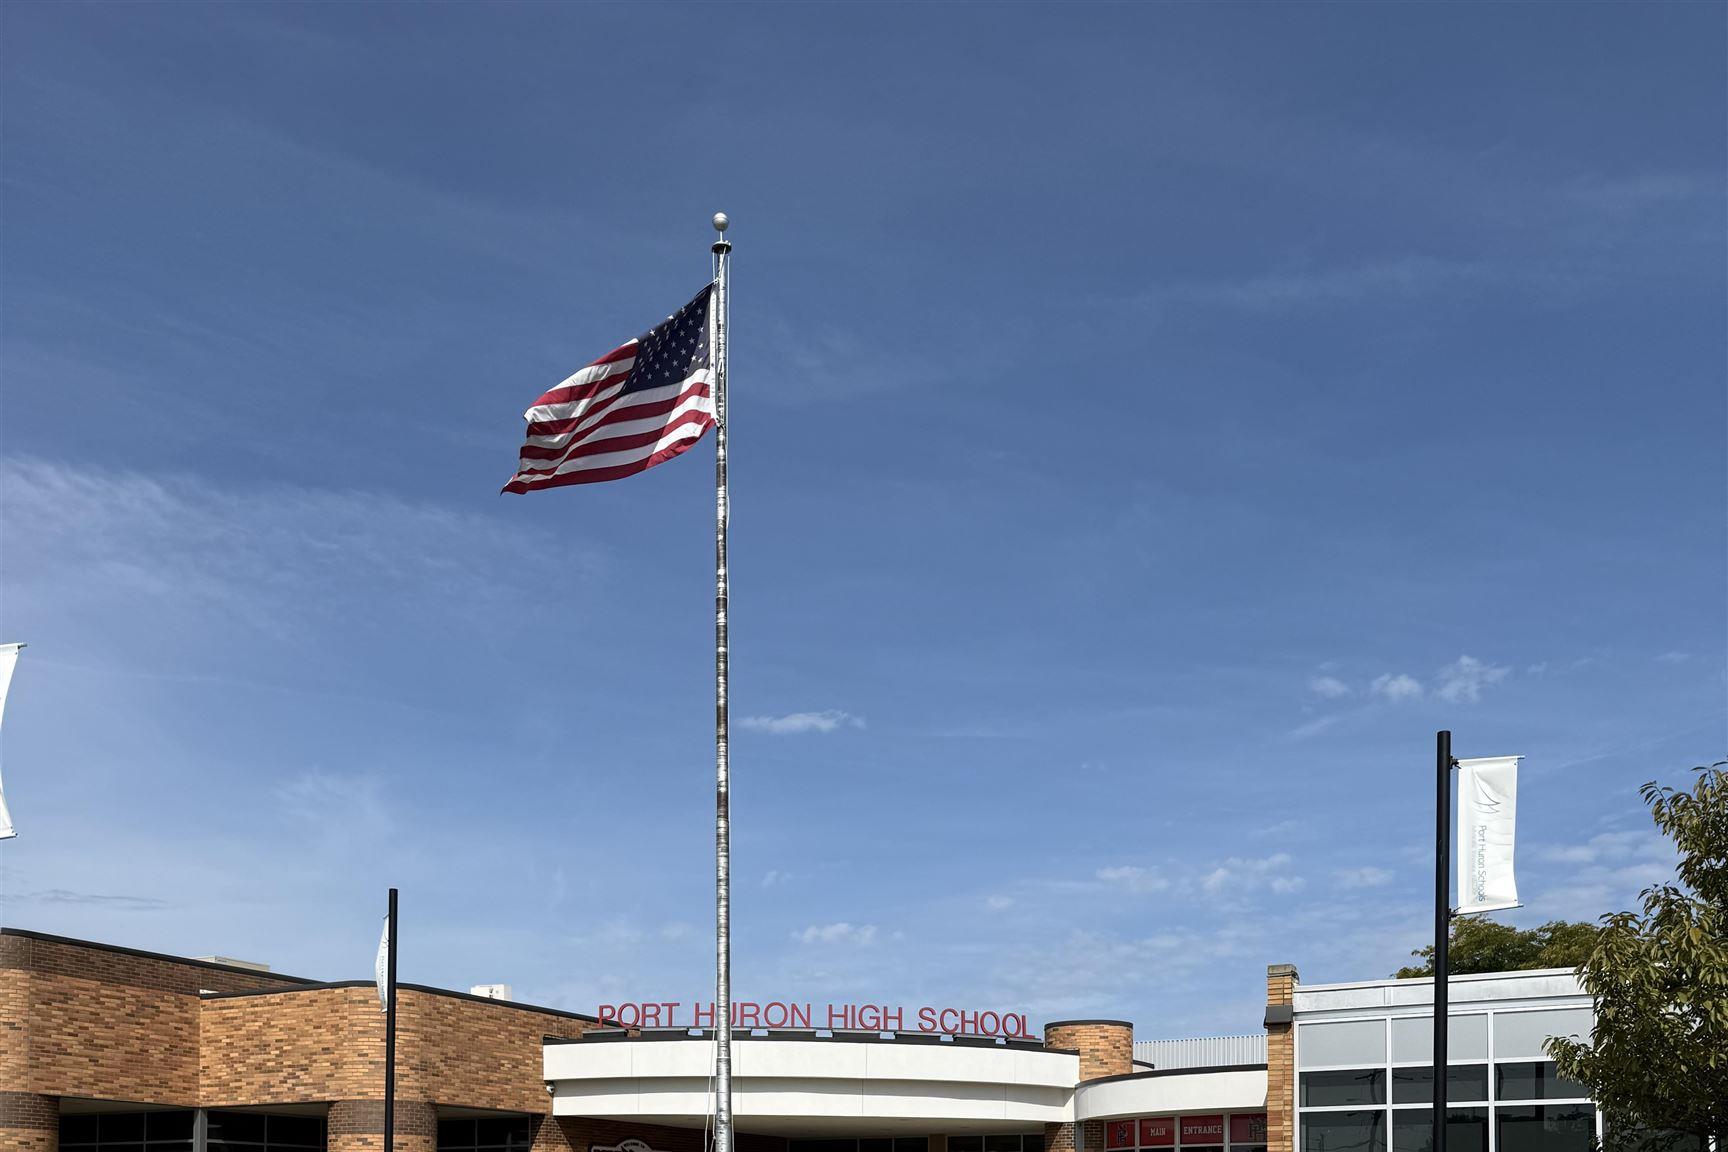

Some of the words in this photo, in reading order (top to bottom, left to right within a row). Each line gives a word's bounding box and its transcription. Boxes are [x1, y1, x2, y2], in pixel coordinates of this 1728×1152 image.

[1478, 825, 1487, 842] Port
[1477, 843, 1487, 869] Huron
[1477, 870, 1487, 902] Schools
[599, 1002, 680, 1029] PORT
[828, 1004, 903, 1032] HIGH
[917, 1006, 1036, 1040] SCHOOL
[1150, 1127, 1166, 1137] MAIN
[1183, 1124, 1223, 1135] ENTRANCE
